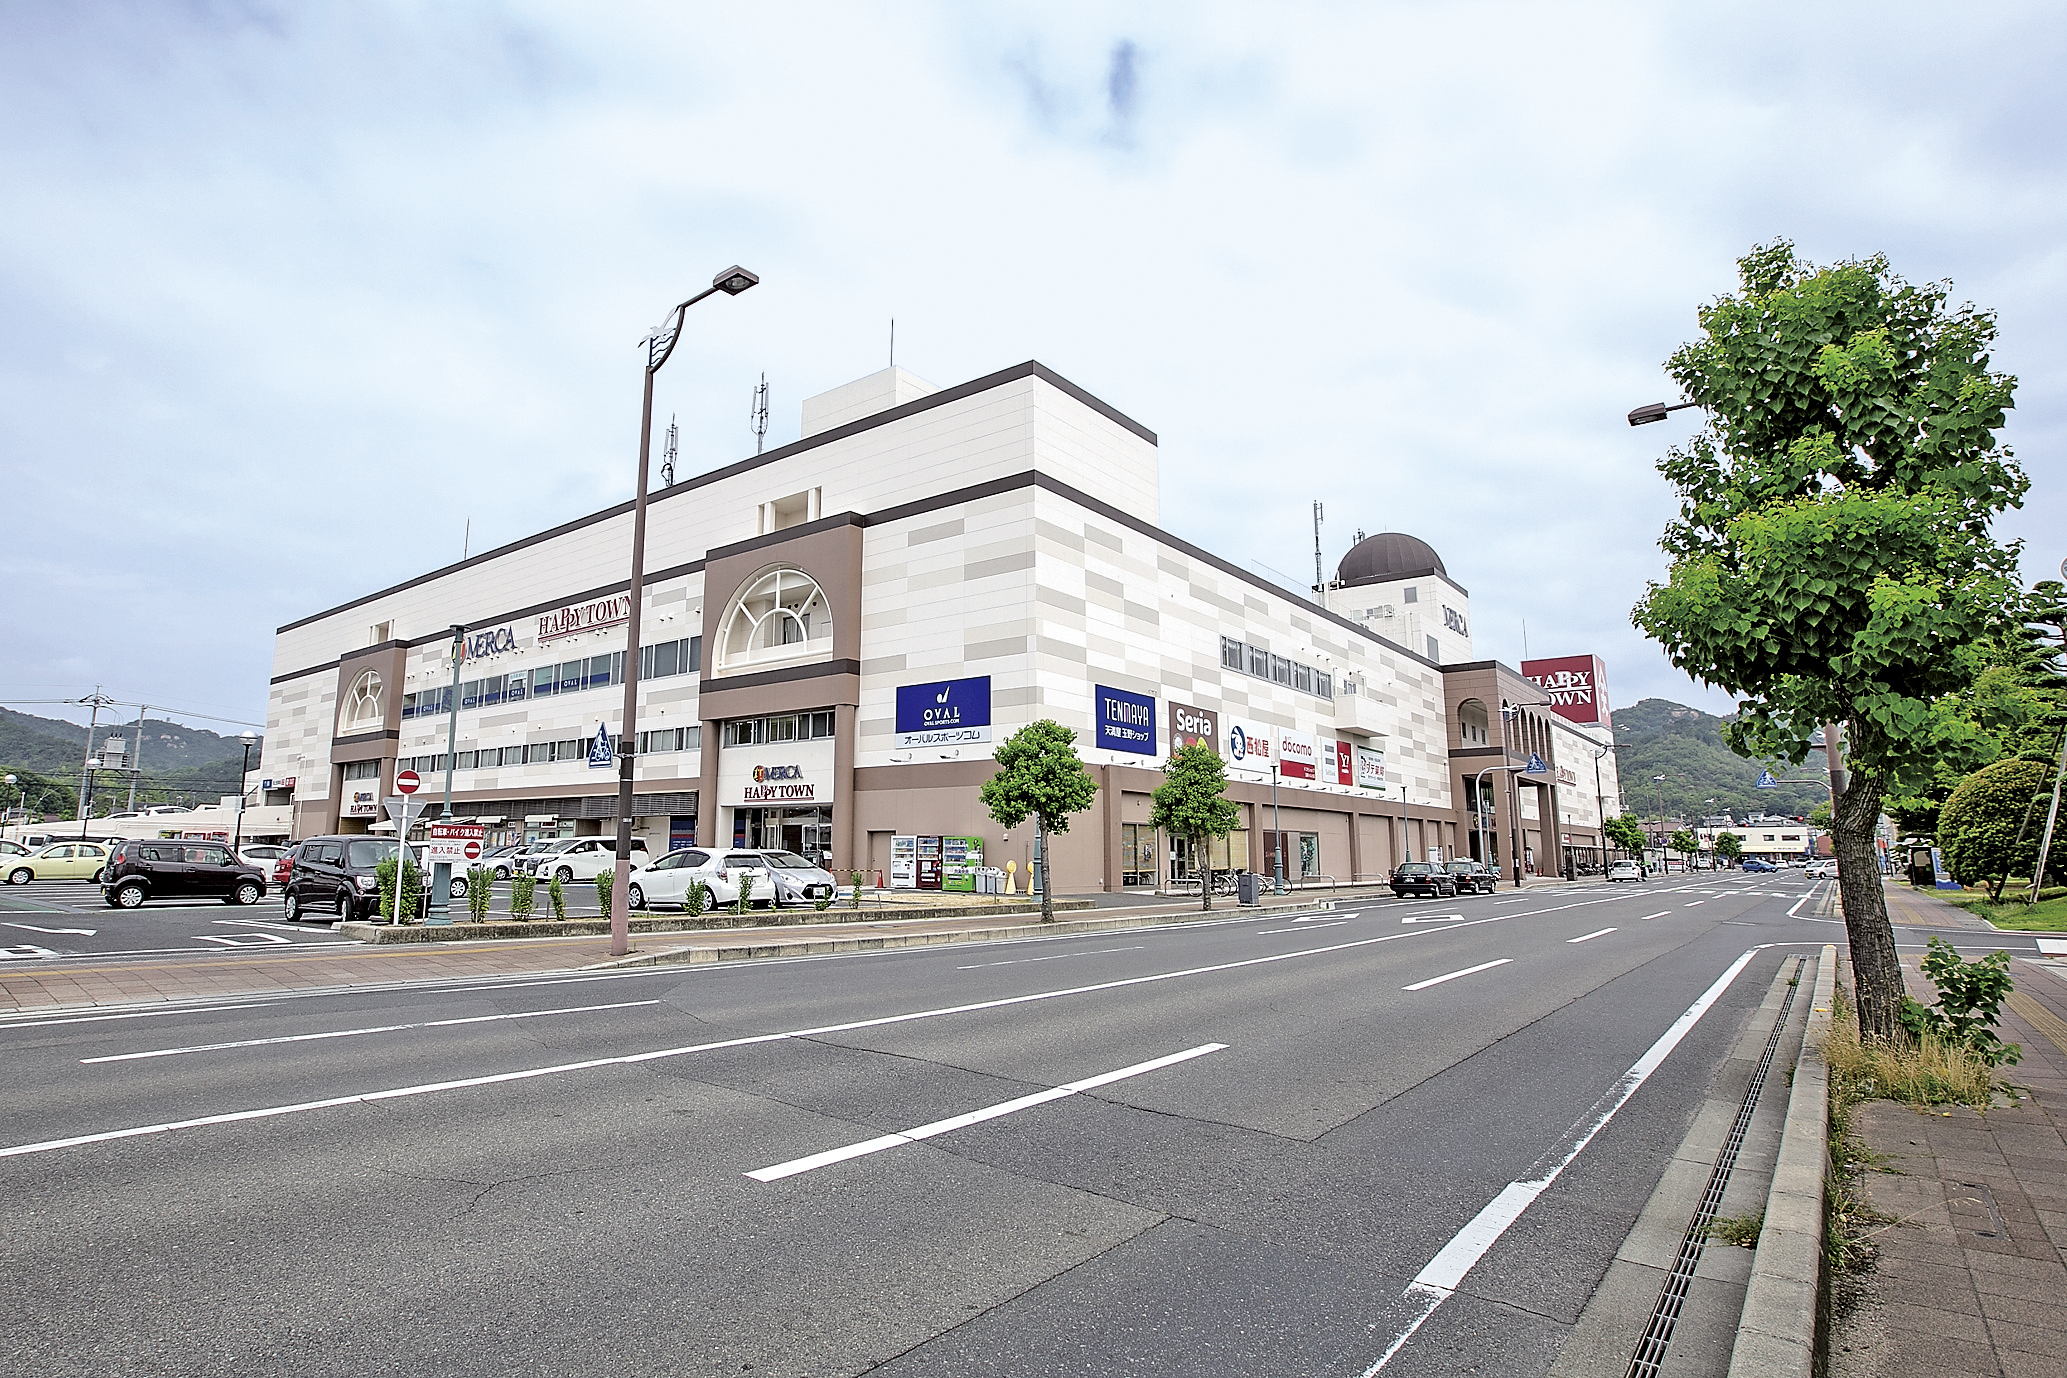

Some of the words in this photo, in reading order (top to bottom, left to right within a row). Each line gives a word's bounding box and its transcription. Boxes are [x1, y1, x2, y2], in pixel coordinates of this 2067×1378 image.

[538, 606, 585, 635] HAPPY
[466, 625, 517, 660] MERCA
[923, 706, 960, 721] OVAL
[1104, 697, 1149, 727] TENMAYA
[1176, 708, 1212, 736] Seria
[904, 730, 981, 745] オーバルスポーツコム
[1104, 725, 1122, 738] 天満屋
[1246, 736, 1270, 758] 西松屋
[1282, 736, 1312, 757] docomo
[764, 764, 804, 781] MERCA
[744, 785, 778, 800] HAPPY
[778, 784, 815, 798] TOWN
